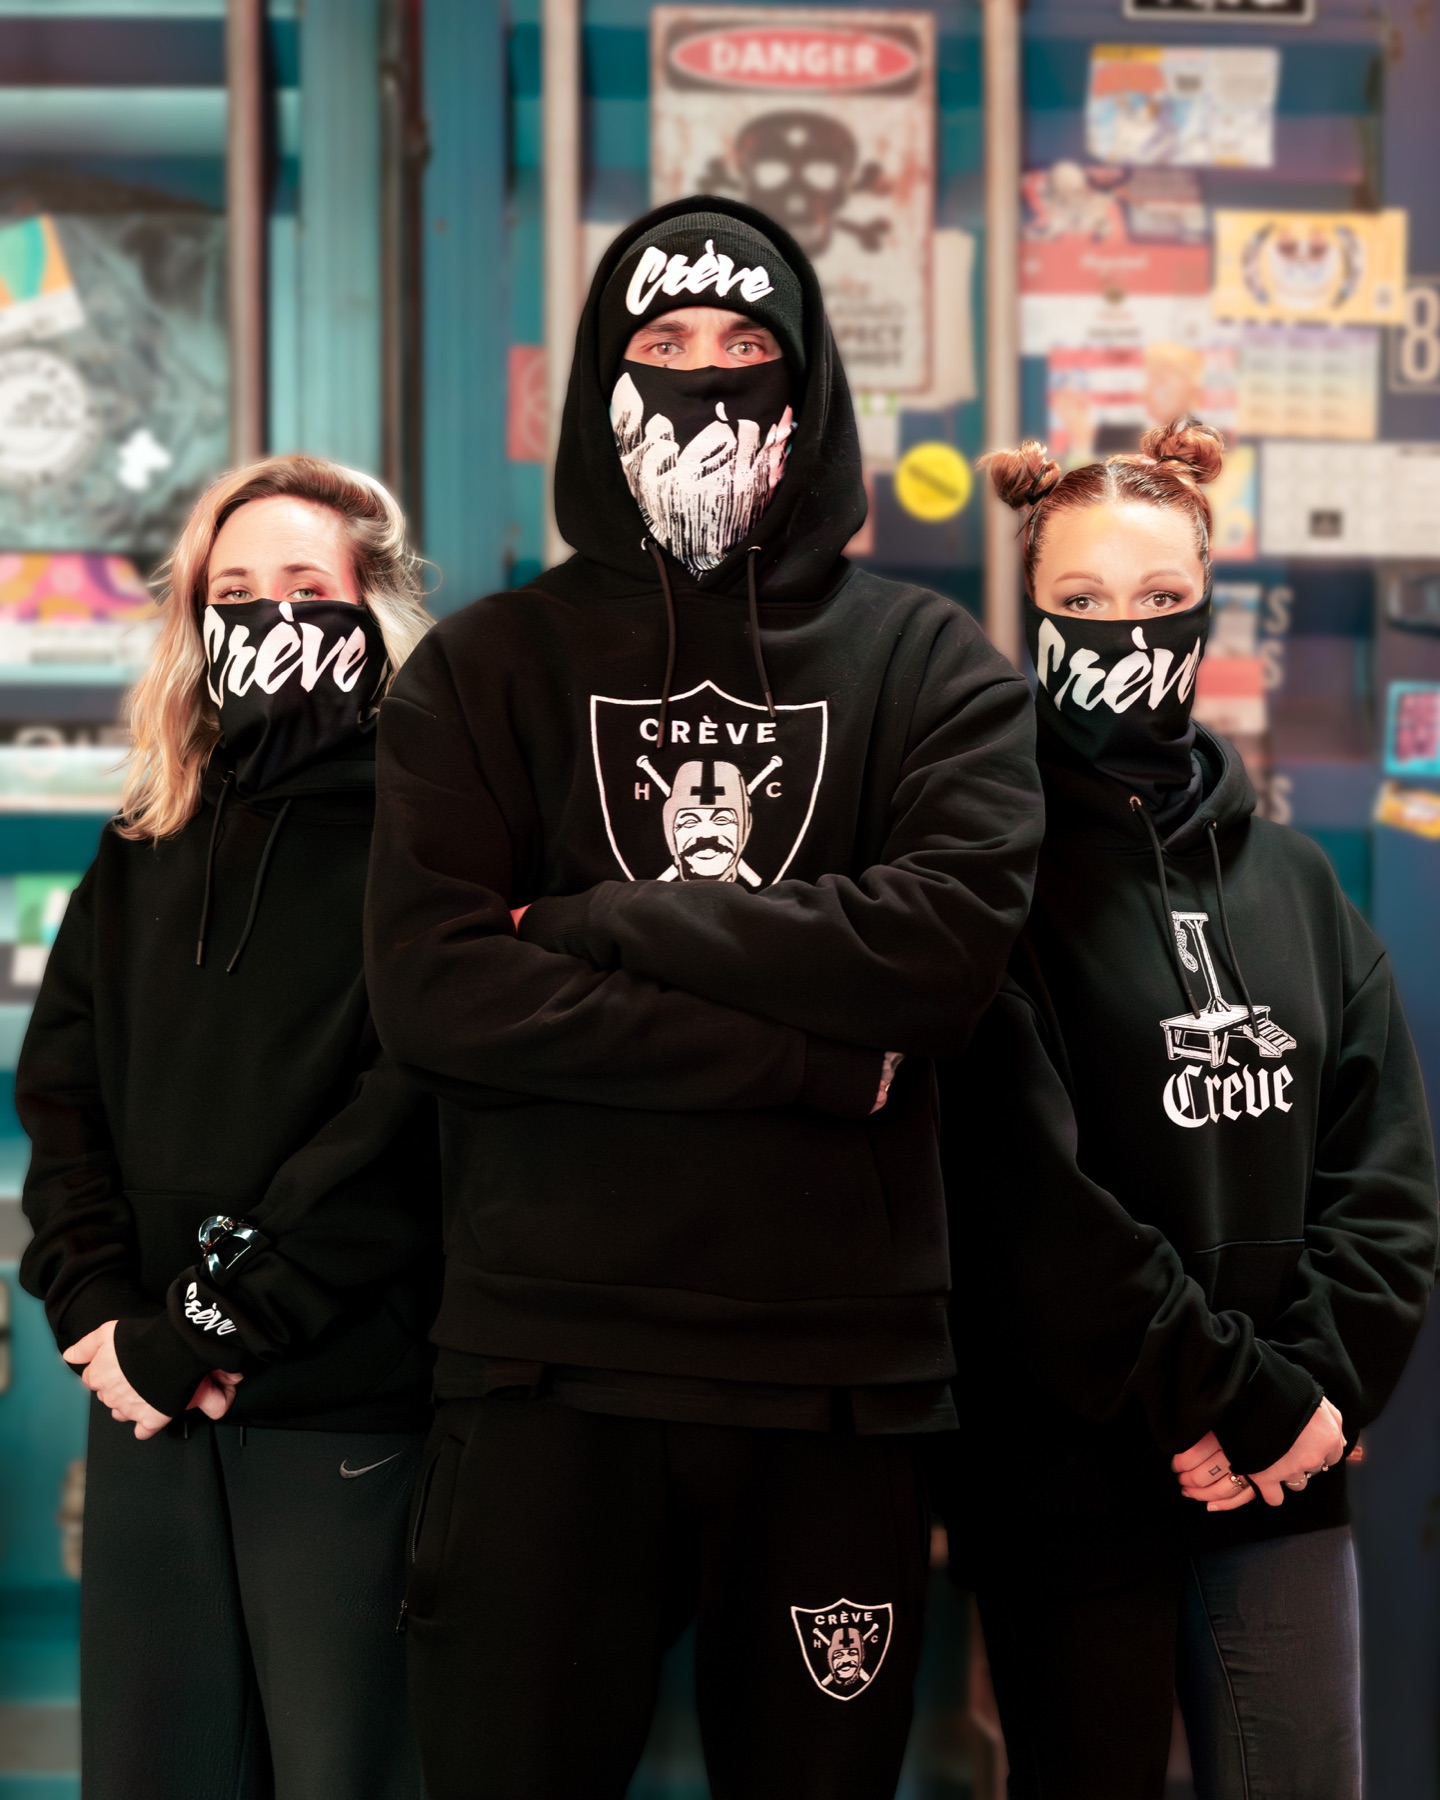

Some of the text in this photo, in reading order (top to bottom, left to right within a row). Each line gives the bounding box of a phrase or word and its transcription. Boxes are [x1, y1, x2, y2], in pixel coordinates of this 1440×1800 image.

[710, 39, 878, 76] DANGER
[626, 239, 774, 316] Crève
[203, 601, 368, 710] Crève
[639, 715, 777, 744] CRÈVE
[634, 782, 783, 800] H C
[1162, 1055, 1294, 1128] Crève
[814, 1611, 873, 1625] CRÈVE
[814, 1640, 821, 1648] H
